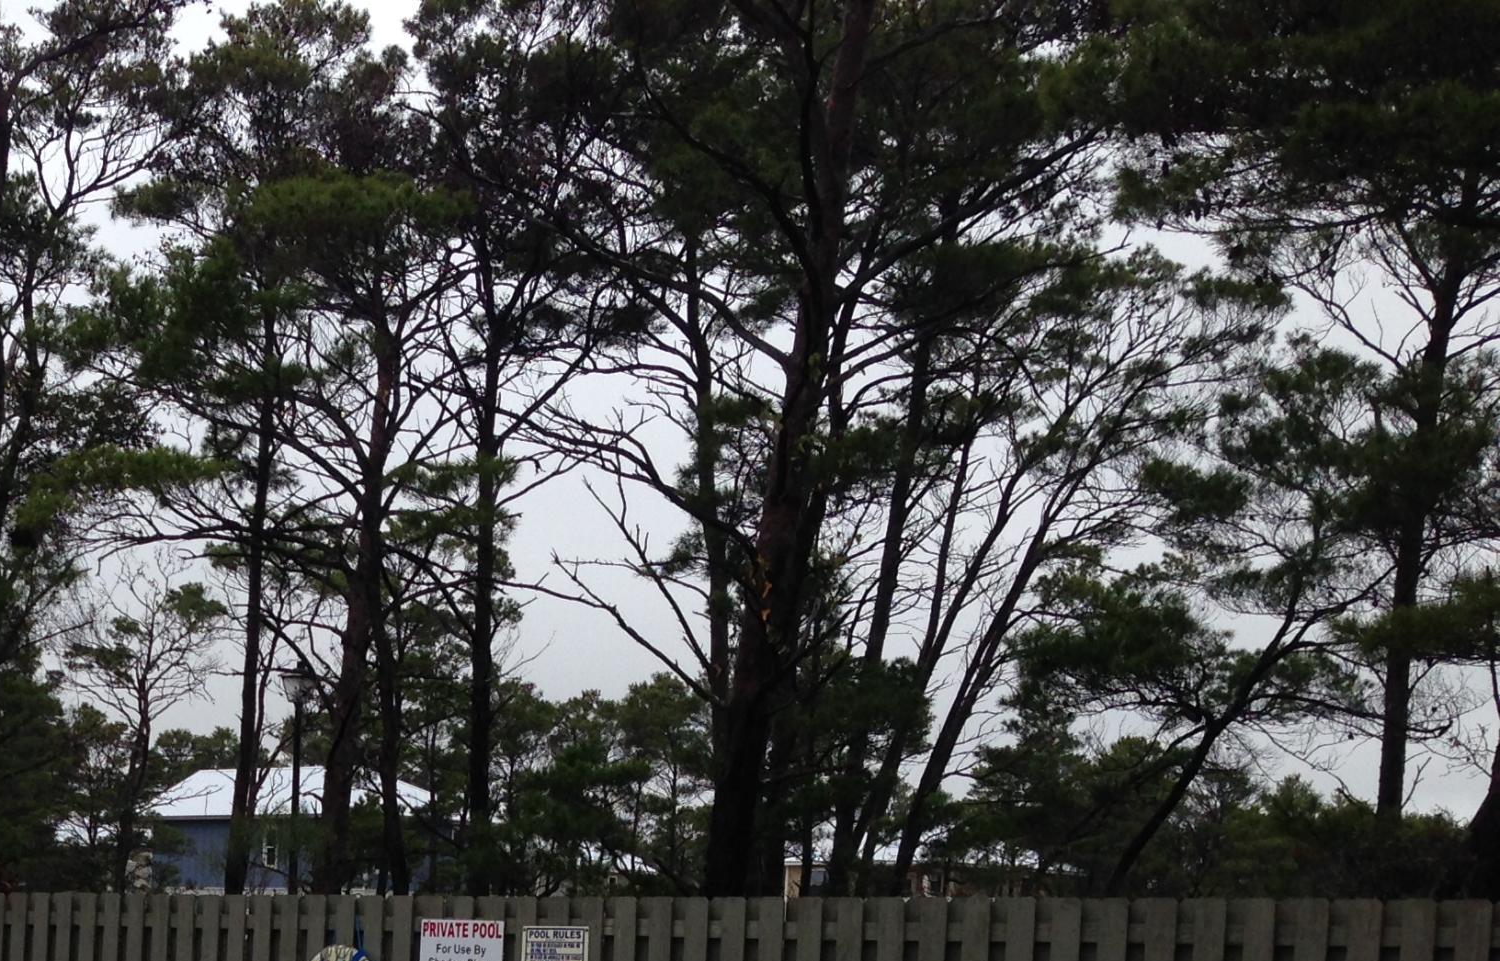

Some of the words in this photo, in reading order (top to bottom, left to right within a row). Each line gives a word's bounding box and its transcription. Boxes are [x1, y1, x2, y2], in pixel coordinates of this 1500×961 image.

[422, 922, 469, 937] PRIVATE
[472, 923, 502, 938] POOL
[529, 930, 550, 939] POOL
[553, 930, 581, 939] RULES
[436, 943, 452, 953] For
[454, 944, 471, 955] Use
[474, 944, 486, 957] By
